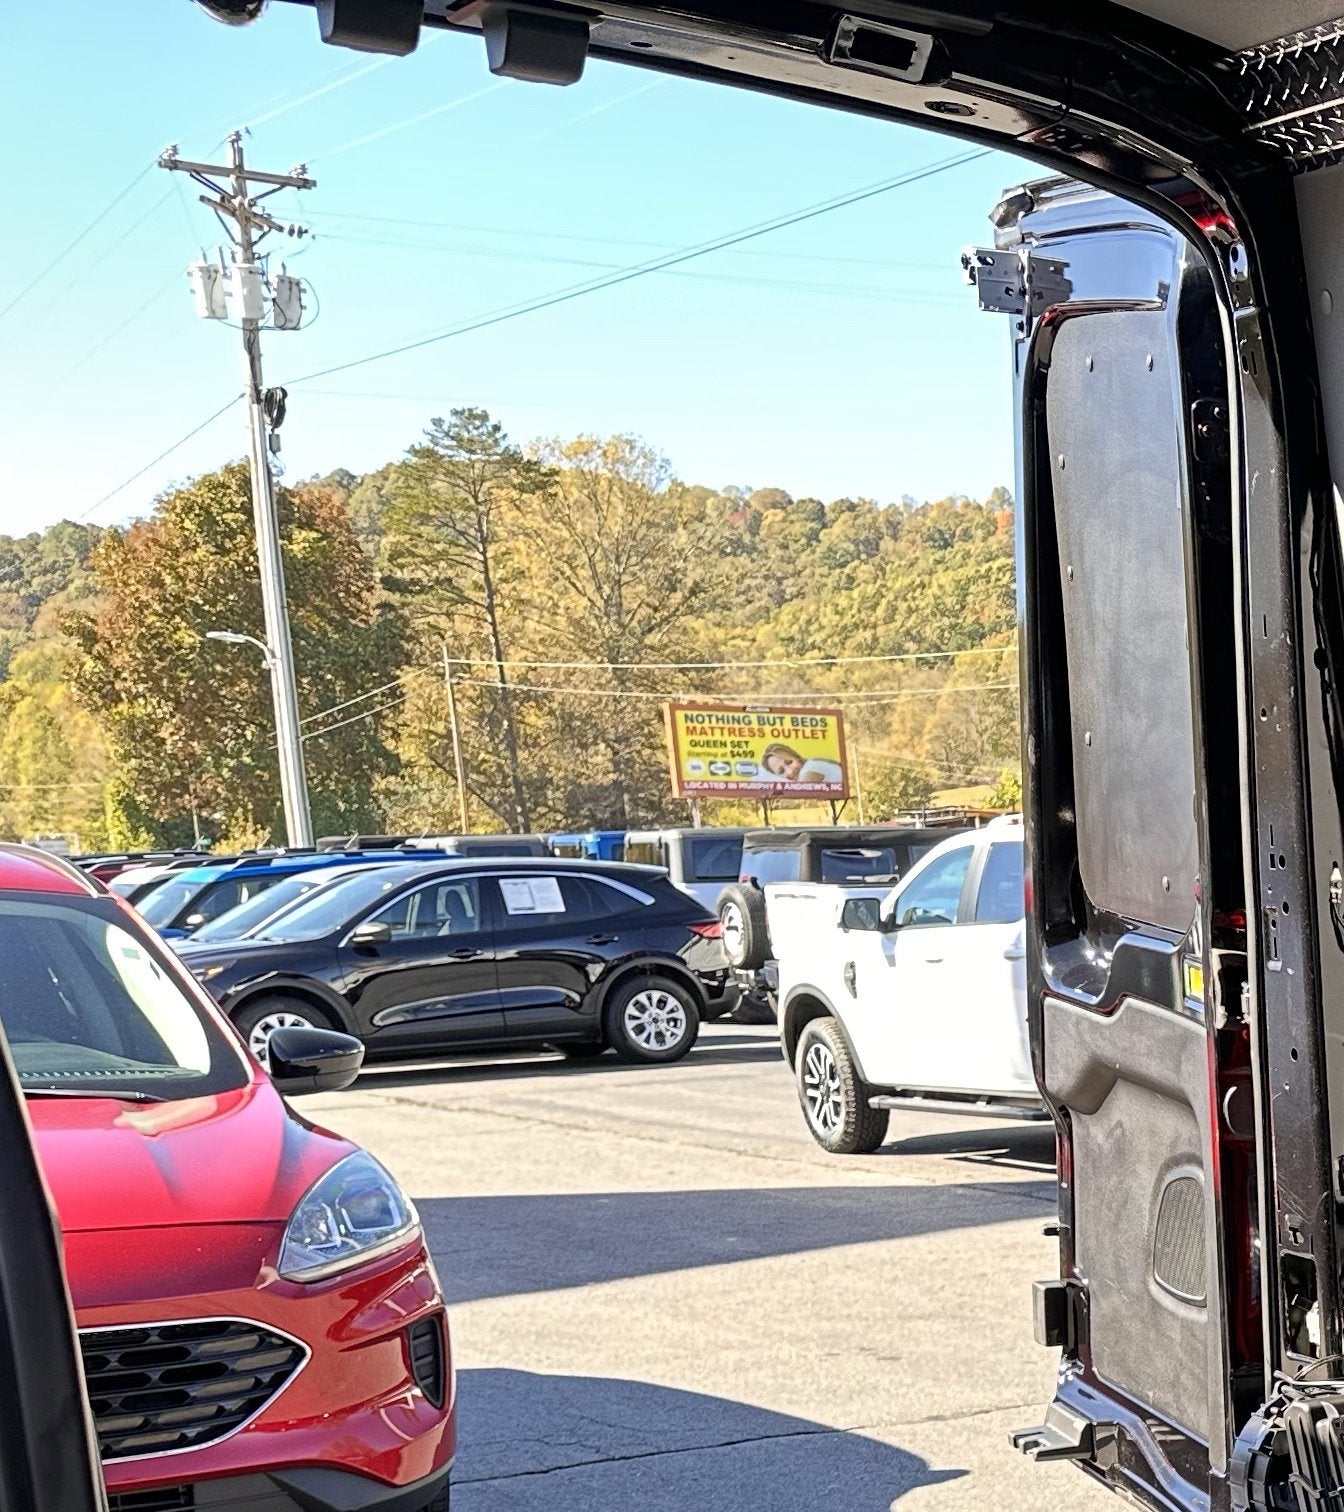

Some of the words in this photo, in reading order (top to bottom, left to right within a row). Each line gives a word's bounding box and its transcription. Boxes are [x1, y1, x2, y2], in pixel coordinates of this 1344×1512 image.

[684, 713, 751, 725] NOTHING
[757, 715, 786, 727] BUT
[791, 716, 828, 728] BEDS
[685, 726, 766, 738] MATTRESS
[771, 728, 828, 740] OUTLET
[689, 739, 727, 748] QUEEN
[730, 740, 750, 749] SET
[730, 750, 755, 759] $499
[684, 781, 726, 789] LOCATED
[738, 782, 774, 790] MURPHY
[776, 782, 783, 790] &
[784, 782, 830, 792] ANDREWS,
[830, 783, 843, 791] NC
